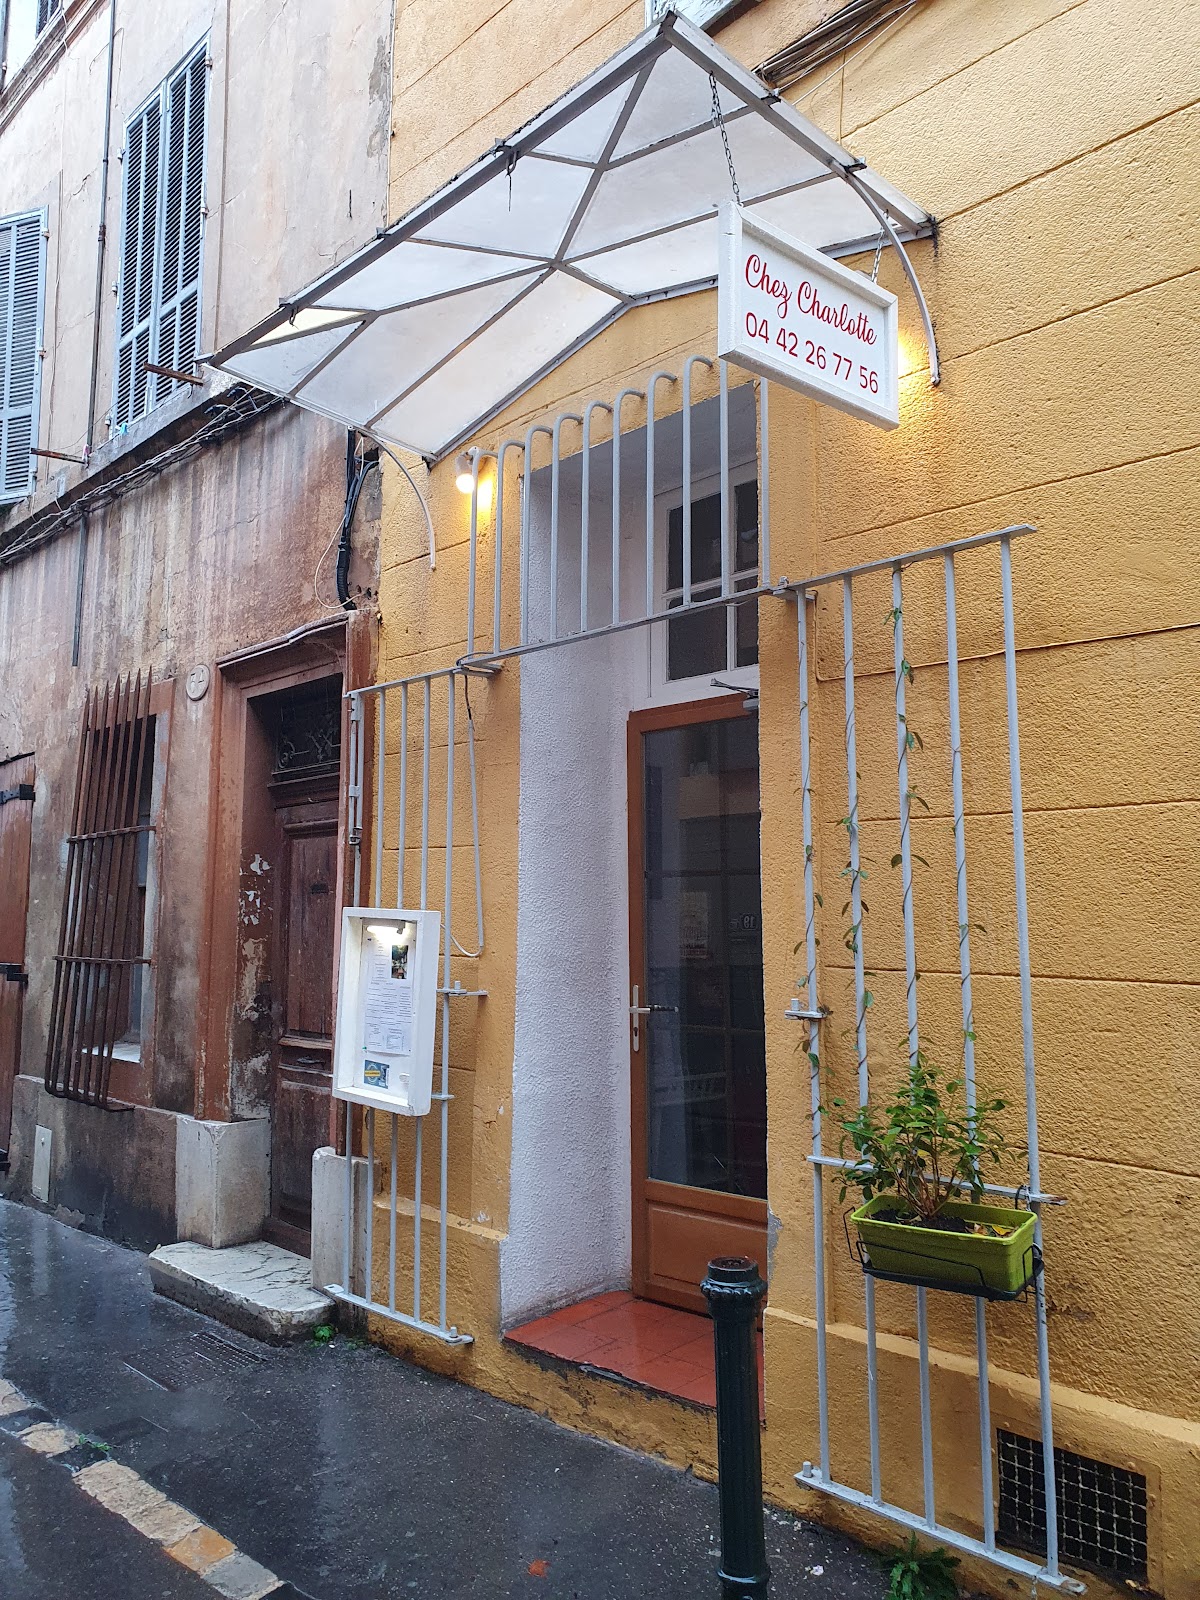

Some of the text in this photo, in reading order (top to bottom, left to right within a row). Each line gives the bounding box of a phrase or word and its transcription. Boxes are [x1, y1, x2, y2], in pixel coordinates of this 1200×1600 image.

[745, 254, 877, 345] Chez Charlotte
[745, 312, 879, 394] 04 42 26 77 56
